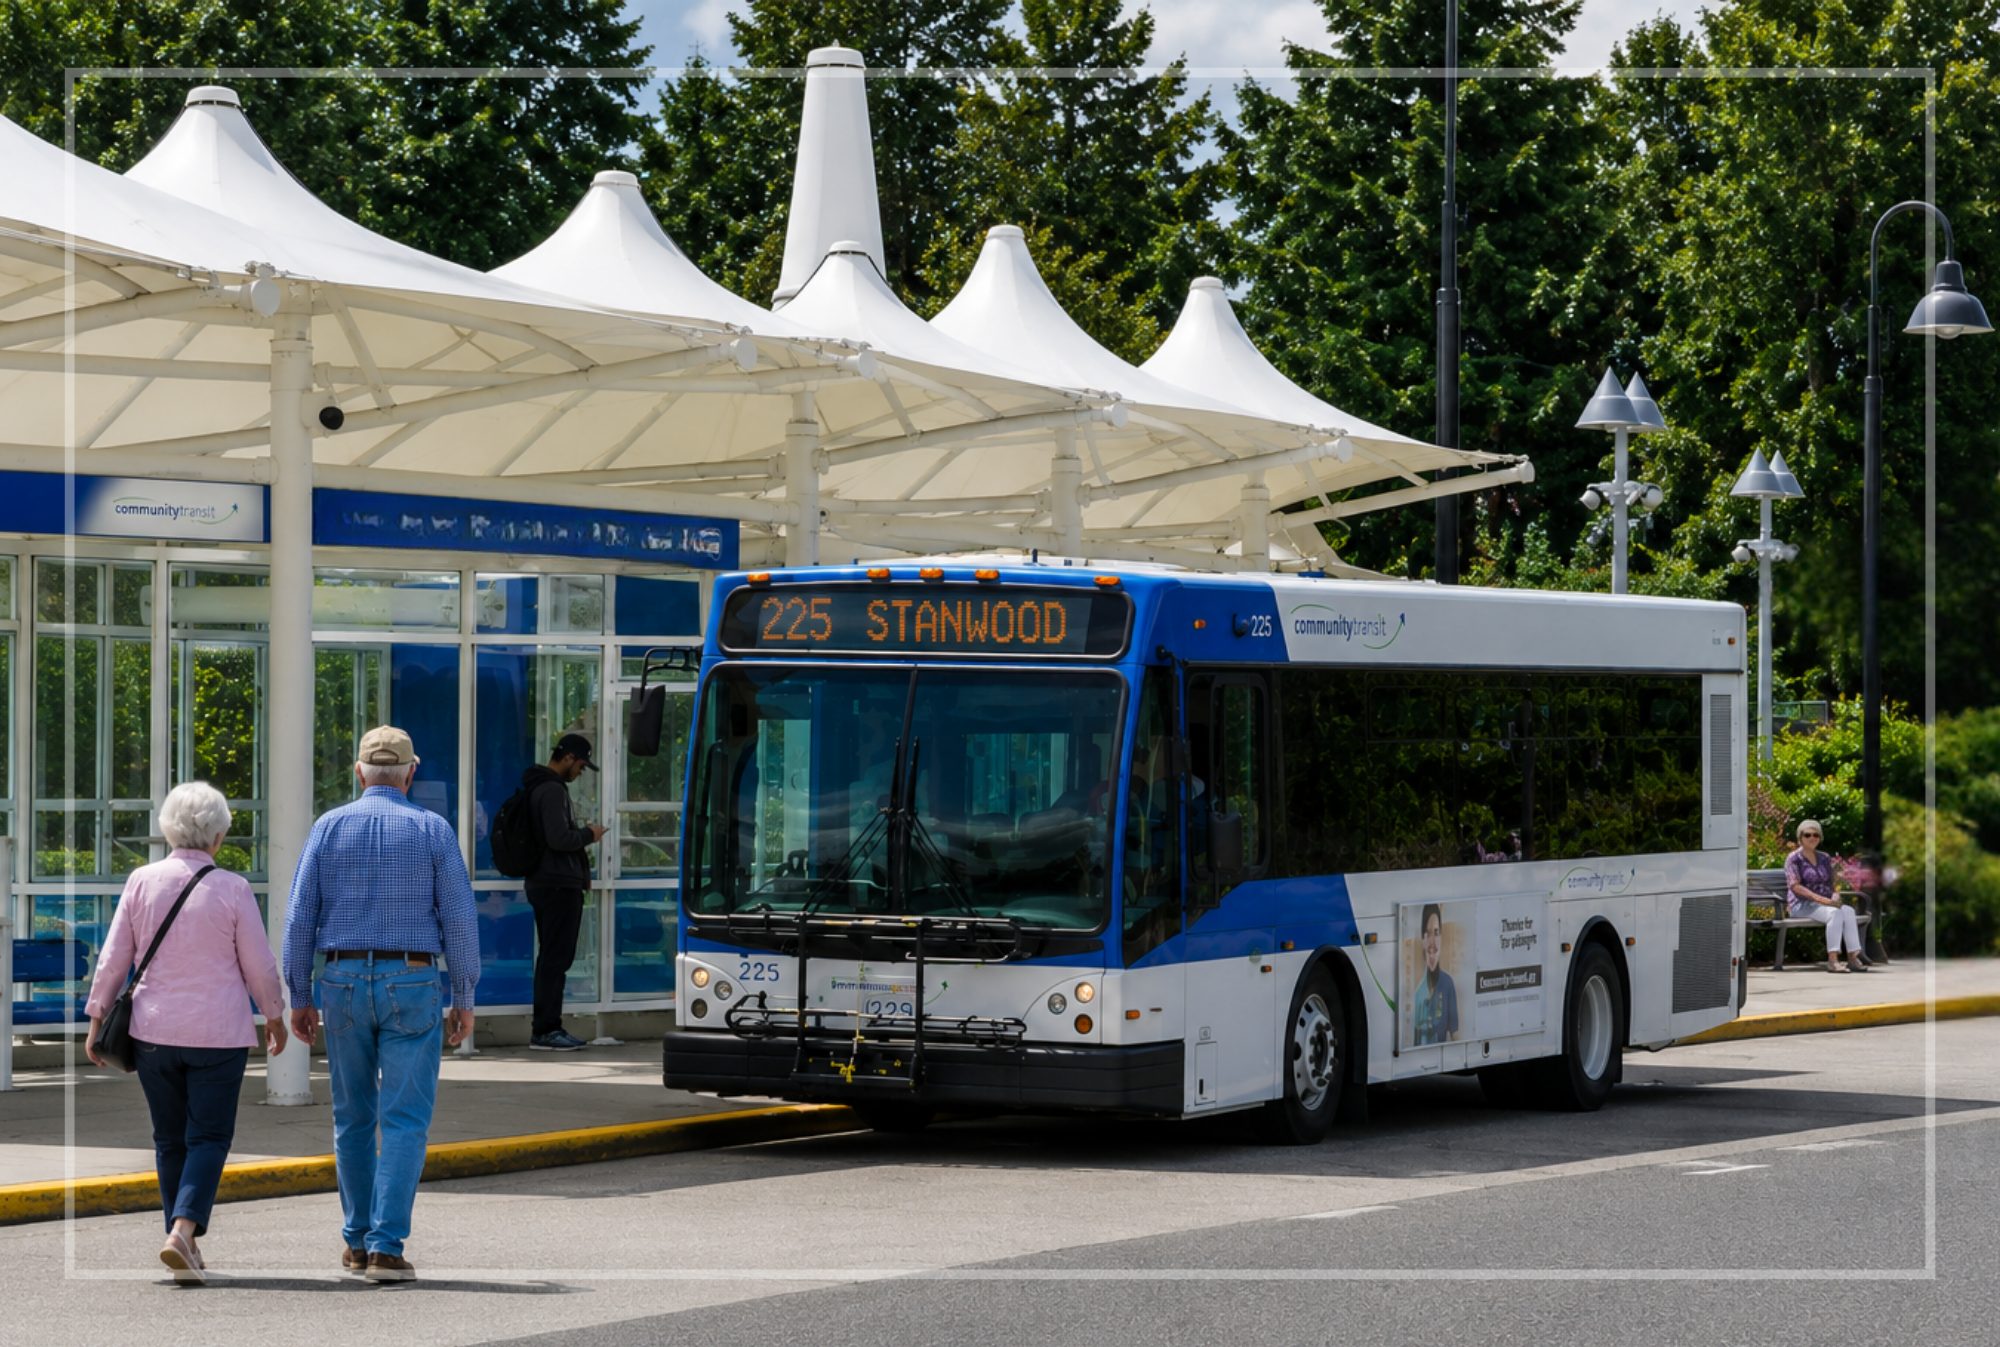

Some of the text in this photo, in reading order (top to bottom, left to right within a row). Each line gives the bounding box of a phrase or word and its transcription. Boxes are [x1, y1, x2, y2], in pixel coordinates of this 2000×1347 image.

[115, 503, 216, 520] communitytransit
[762, 596, 1067, 644] 225 STANWOOD
[1251, 615, 1272, 637] 225
[1294, 613, 1387, 642] communitytransit
[739, 961, 780, 982] 225
